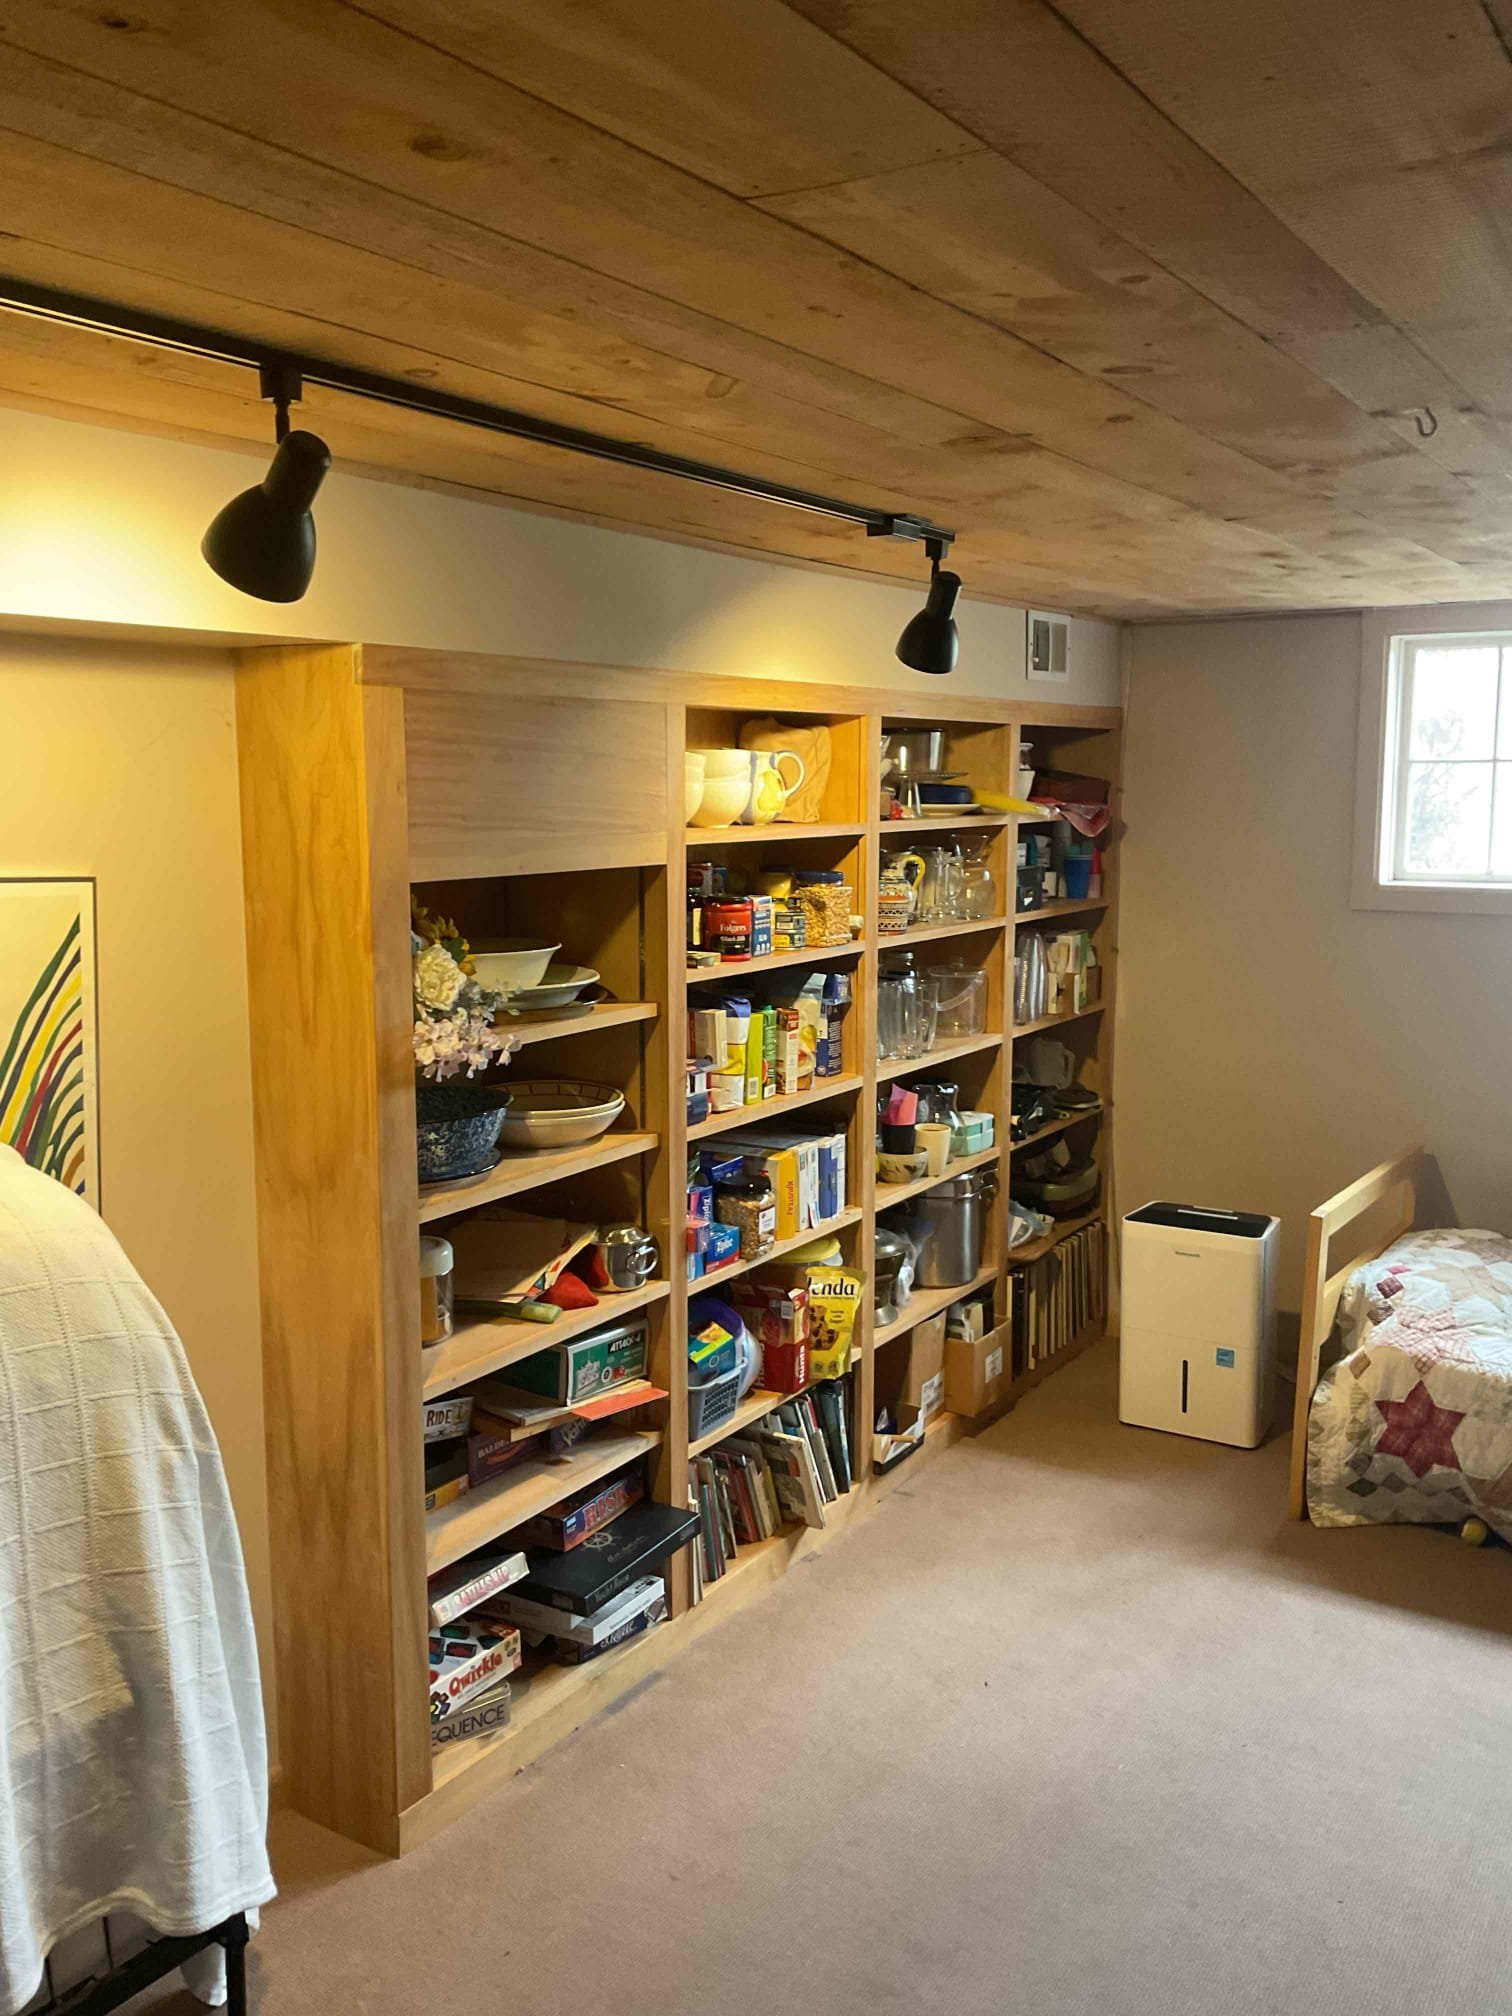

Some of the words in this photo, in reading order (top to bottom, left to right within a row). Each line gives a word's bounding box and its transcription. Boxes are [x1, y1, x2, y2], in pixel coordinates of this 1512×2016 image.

[702, 1197, 711, 1221] Ziplo
[807, 1276, 855, 1296] lenda
[426, 1408, 452, 1428] RIDE
[583, 1485, 628, 1530] RISK
[454, 1565, 510, 1608] BATTLESHIP
[449, 1651, 504, 1697] Qwirkle
[431, 1703, 505, 1746] EQUENCE
